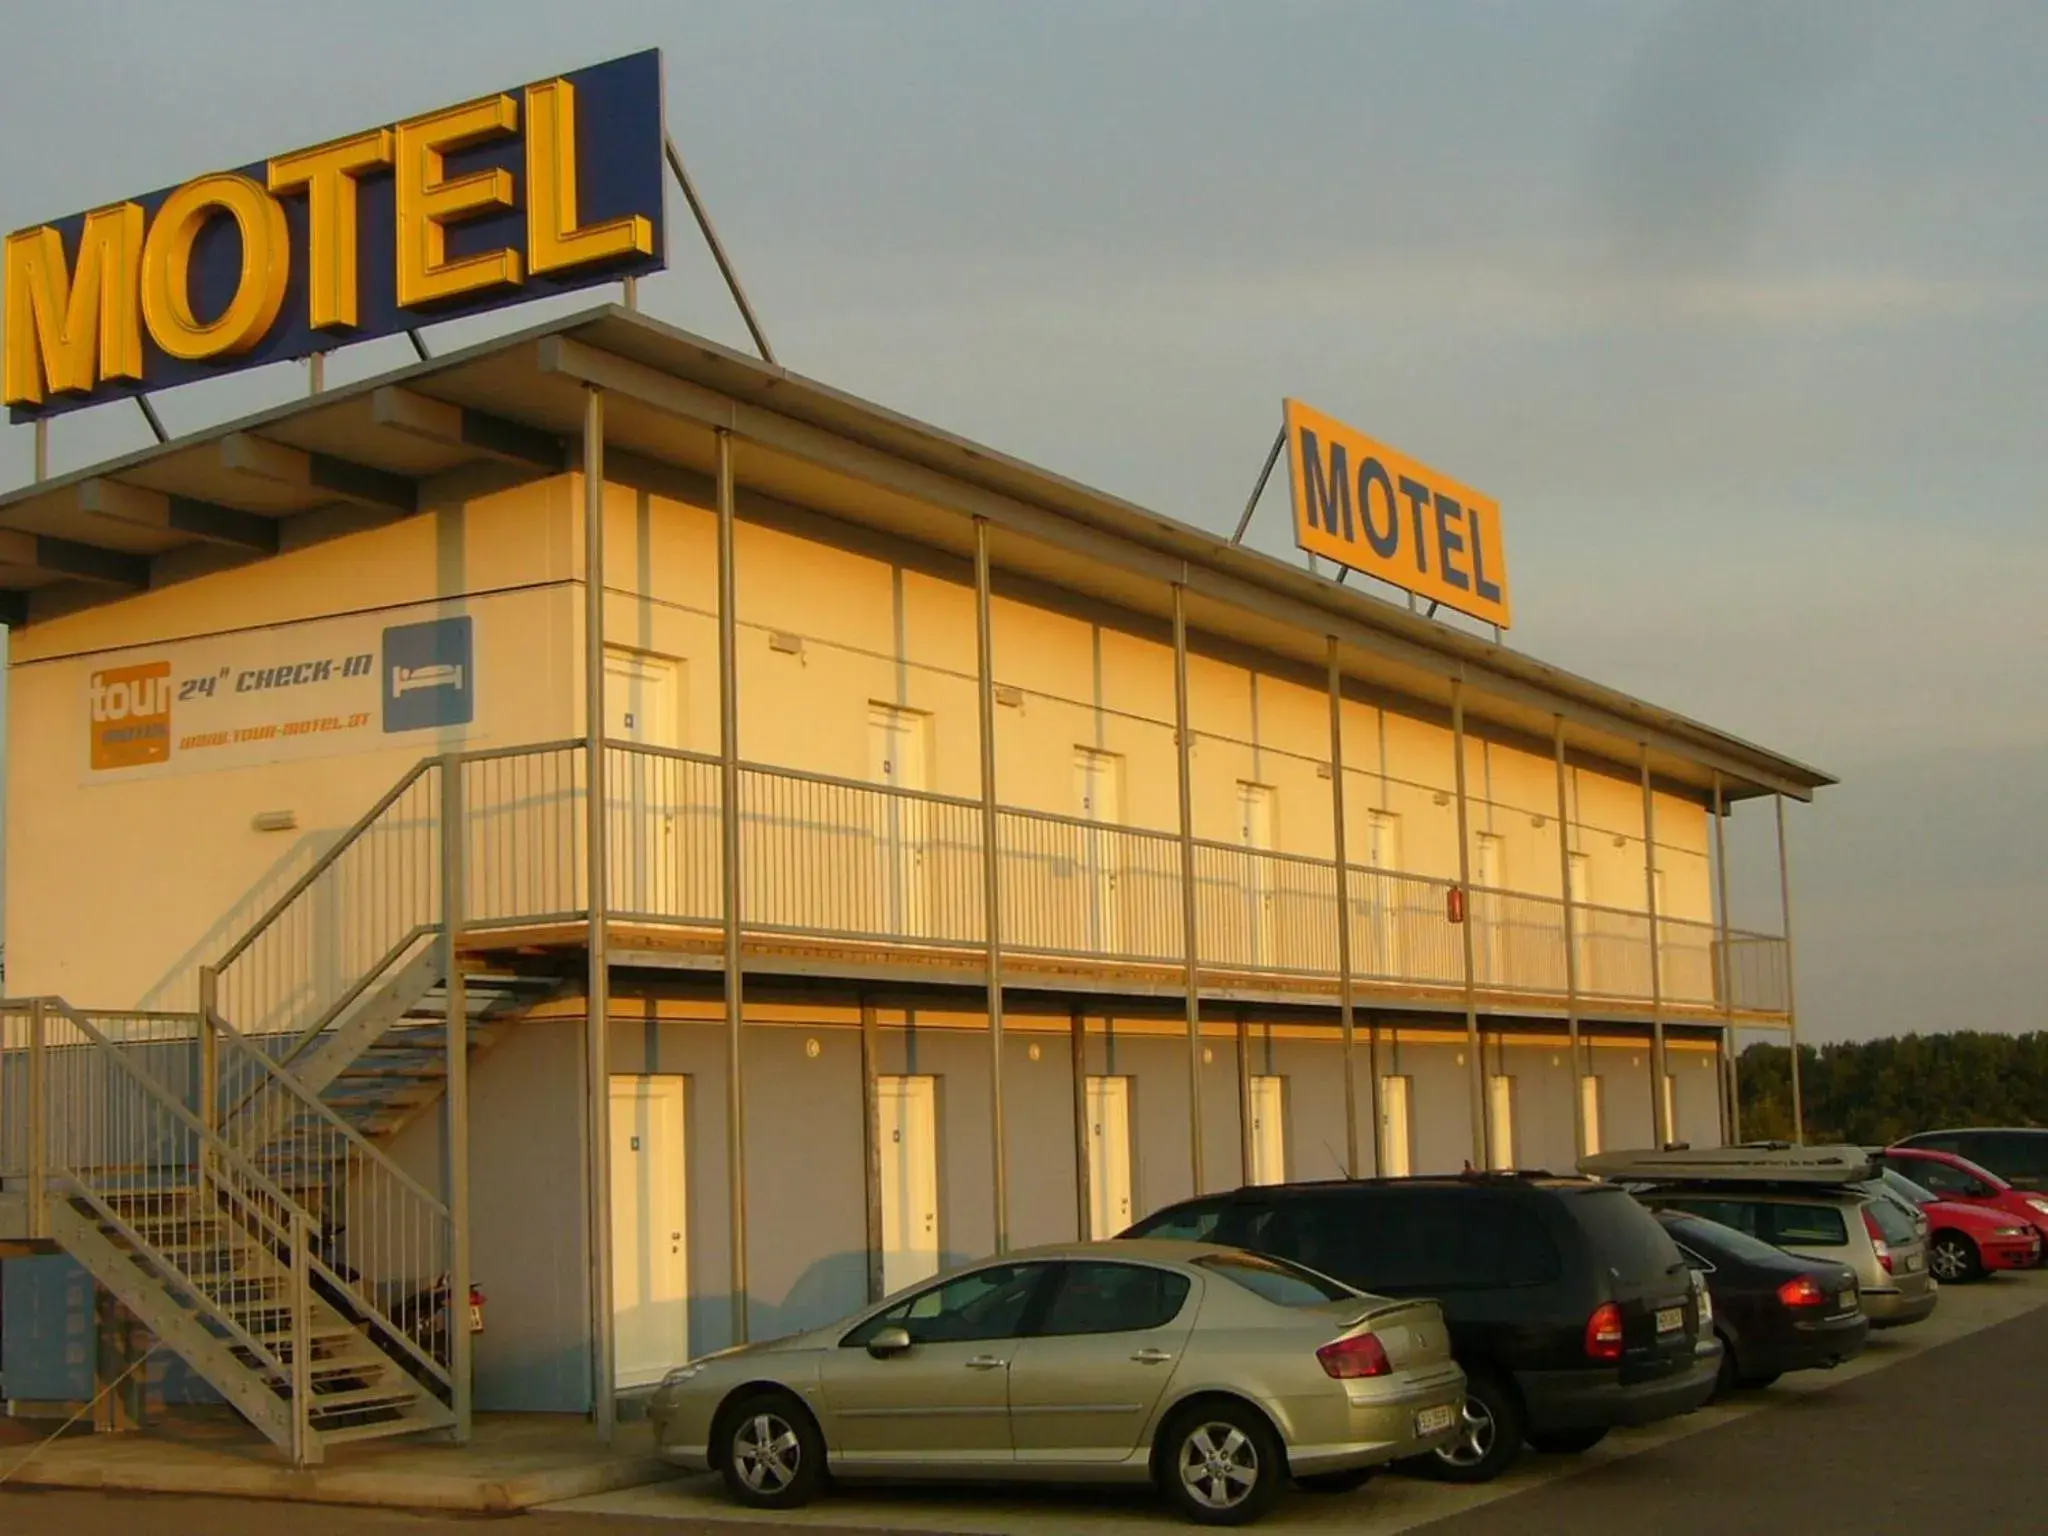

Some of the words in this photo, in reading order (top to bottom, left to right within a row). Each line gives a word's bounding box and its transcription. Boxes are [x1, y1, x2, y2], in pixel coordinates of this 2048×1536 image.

[6, 77, 652, 406] MOTEL
[1300, 426, 1501, 605] MOTEL
[91, 674, 170, 722] tour
